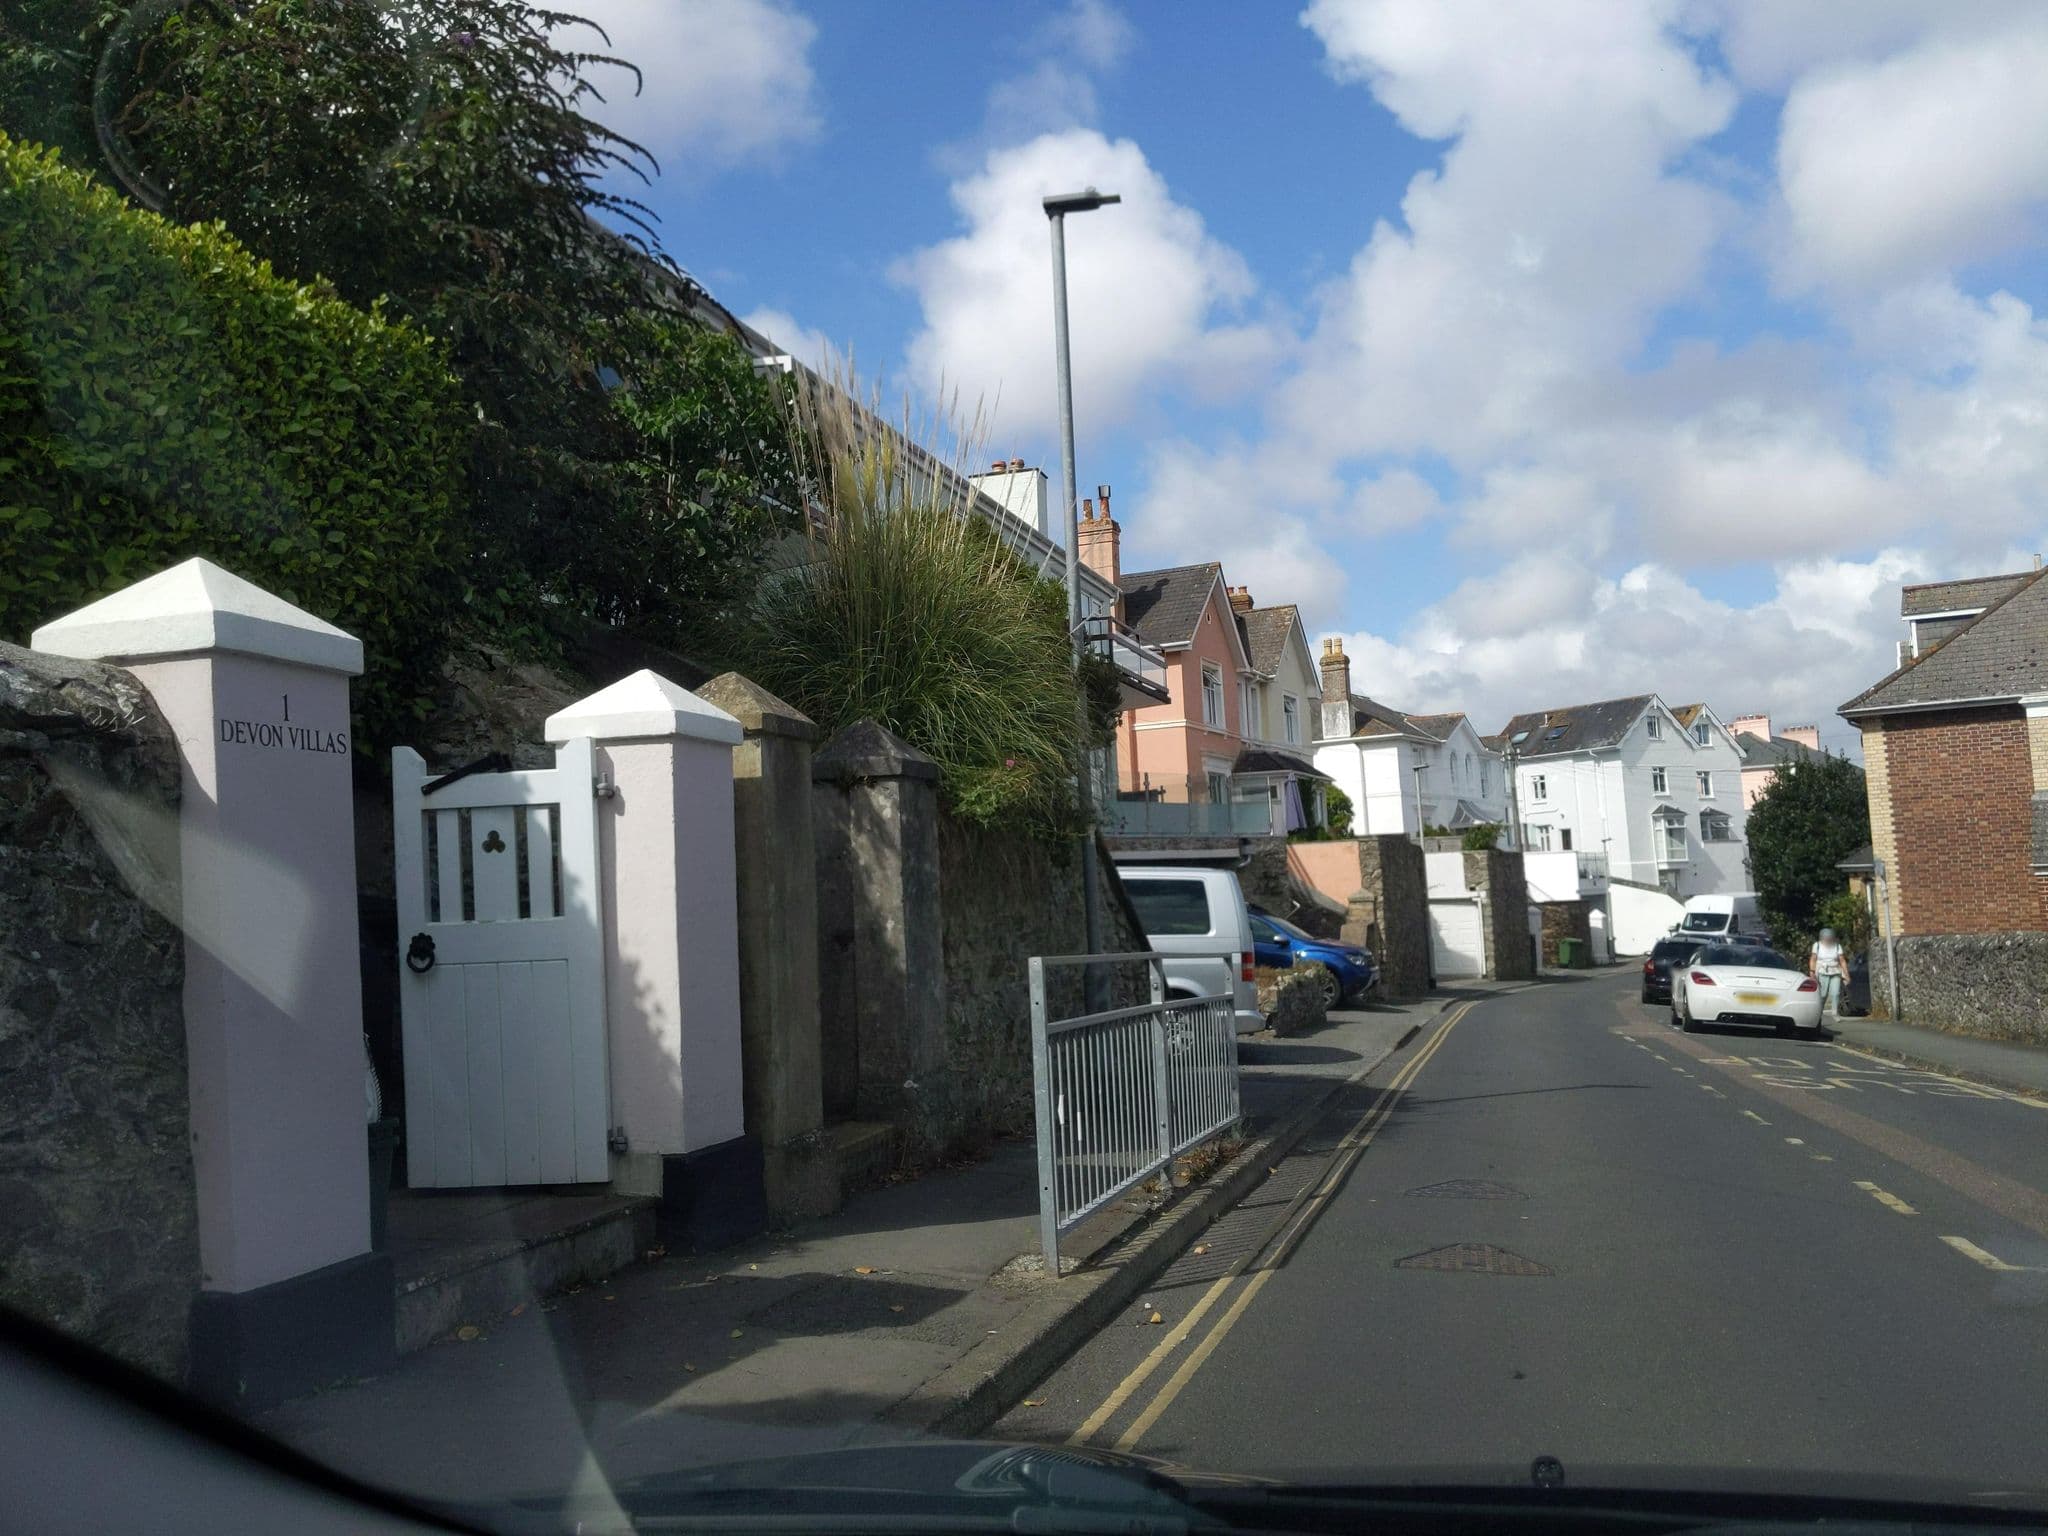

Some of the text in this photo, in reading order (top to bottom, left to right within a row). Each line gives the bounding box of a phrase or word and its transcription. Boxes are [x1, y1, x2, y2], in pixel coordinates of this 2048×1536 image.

[282, 694, 290, 722] 1
[221, 719, 347, 754] DEVON VILLAS
